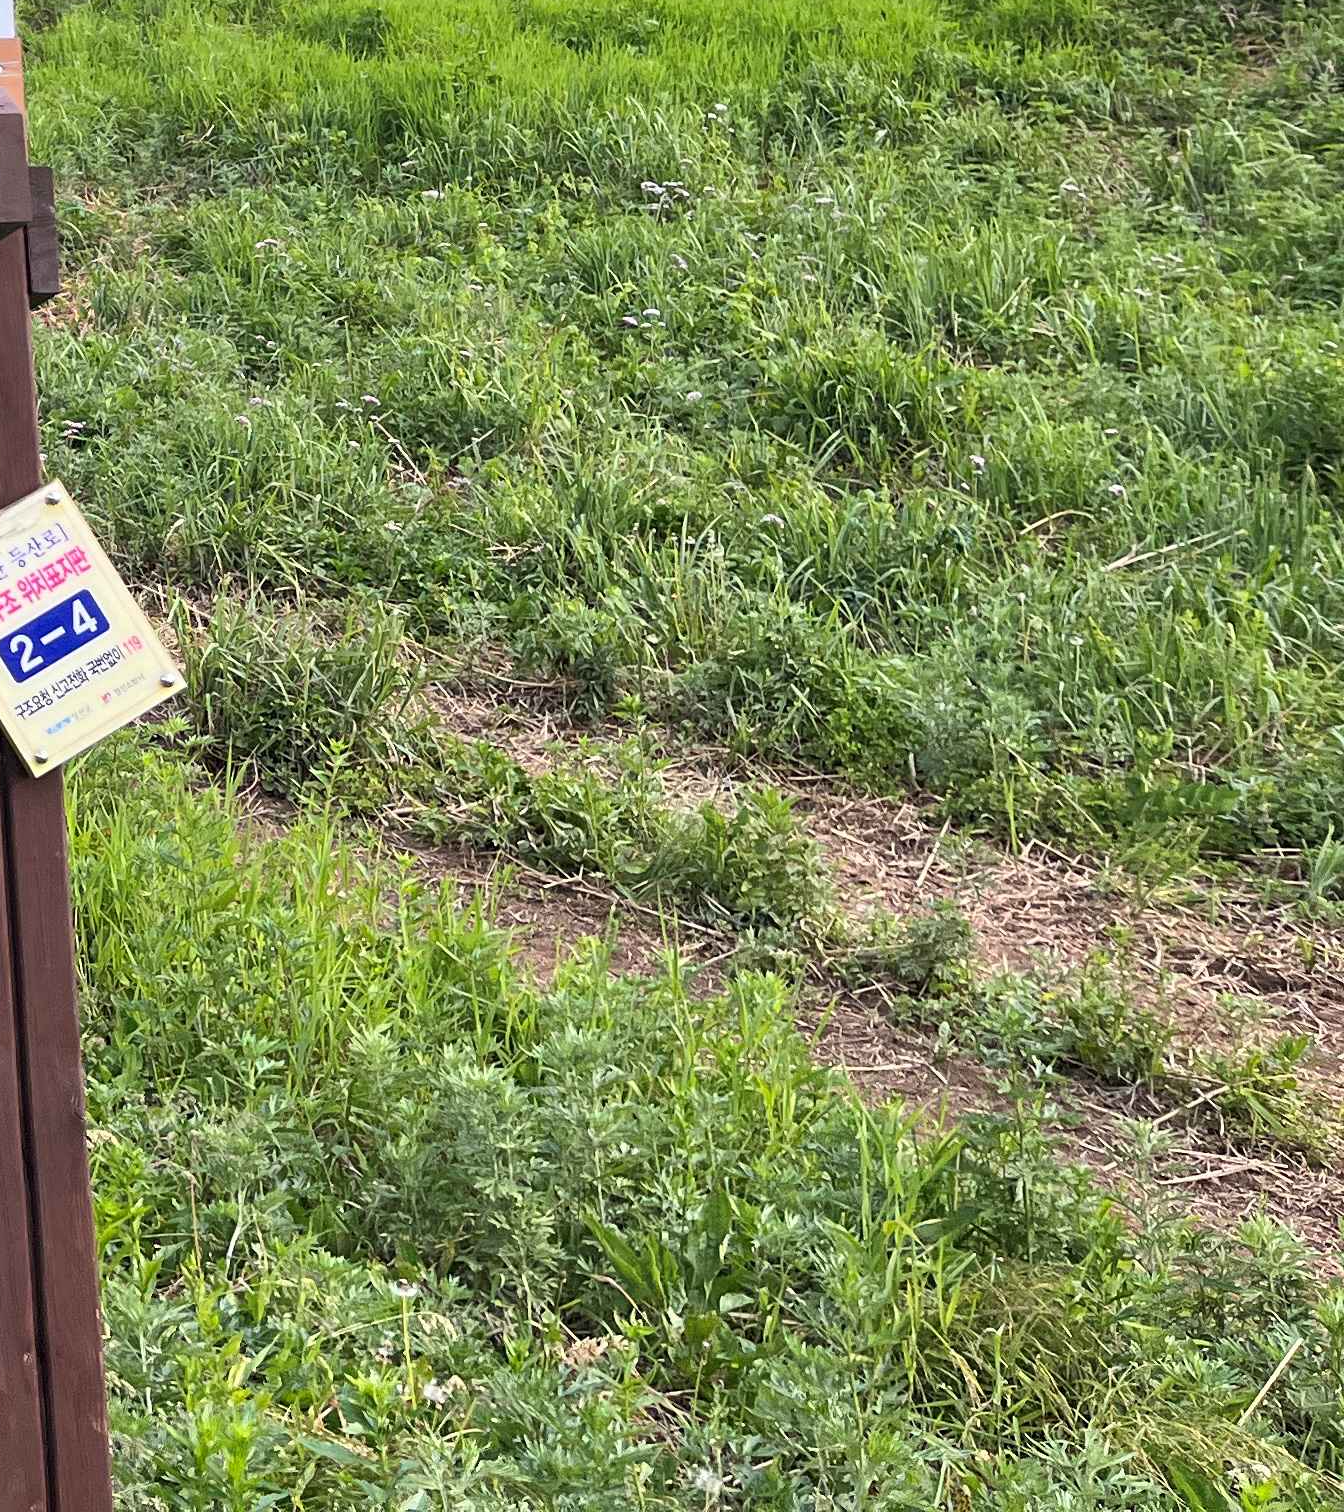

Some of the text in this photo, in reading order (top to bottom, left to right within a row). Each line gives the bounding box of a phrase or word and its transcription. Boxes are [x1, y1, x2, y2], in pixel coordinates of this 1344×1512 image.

[17, 545, 92, 603] 위치표지판
[9, 598, 98, 673] 2-4
[14, 688, 54, 720] 구조요청
[51, 667, 89, 700] 신고전화
[123, 635, 144, 656] 119
